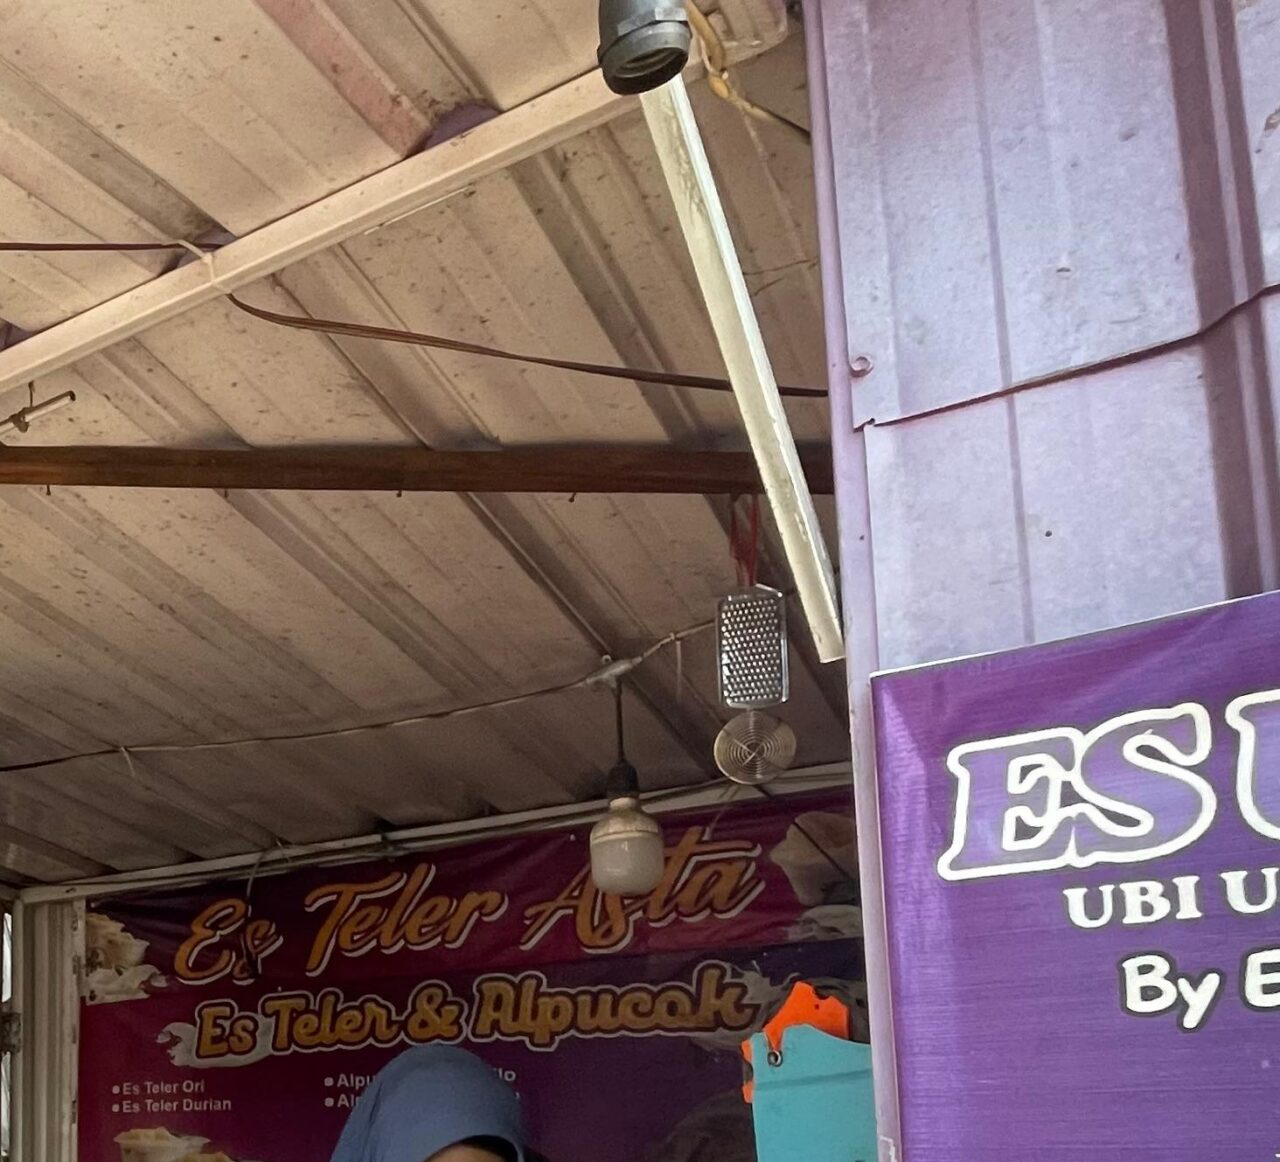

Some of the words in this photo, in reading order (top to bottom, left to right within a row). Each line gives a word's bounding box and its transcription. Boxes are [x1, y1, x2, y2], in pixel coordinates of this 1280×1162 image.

[937, 702, 1217, 882] ES
[174, 898, 283, 985] Es
[304, 863, 509, 977] Teler
[1062, 875, 1203, 929] UBI
[198, 1004, 256, 1059] Es
[264, 994, 404, 1049] Teler
[404, 982, 460, 1041] &
[1122, 954, 1222, 1029] By
[122, 1082, 140, 1095] Es
[144, 1081, 178, 1095] Teler
[122, 1100, 140, 1113] Es
[144, 1099, 178, 1113] Teler
[183, 1098, 232, 1112] Durian
